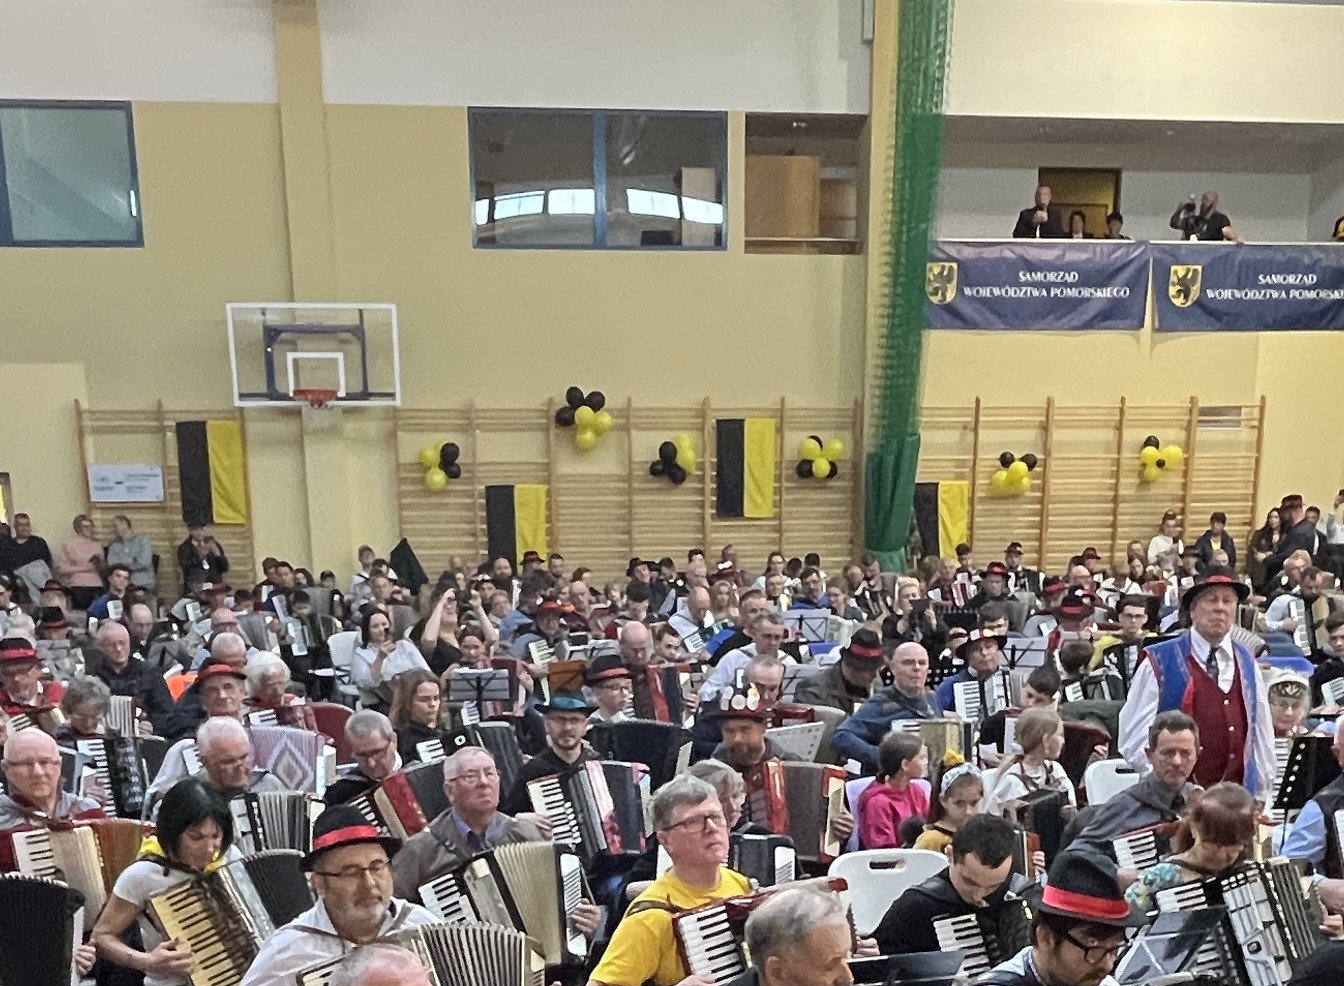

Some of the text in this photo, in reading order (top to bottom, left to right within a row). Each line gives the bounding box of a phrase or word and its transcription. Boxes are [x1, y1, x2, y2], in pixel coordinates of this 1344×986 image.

[1018, 270, 1079, 284] SAMORZĄD
[963, 284, 1130, 299] WOJEWÓDZTWA POMORSKIEGO
[1206, 286, 1286, 300] WOJEWÓDZTWA
